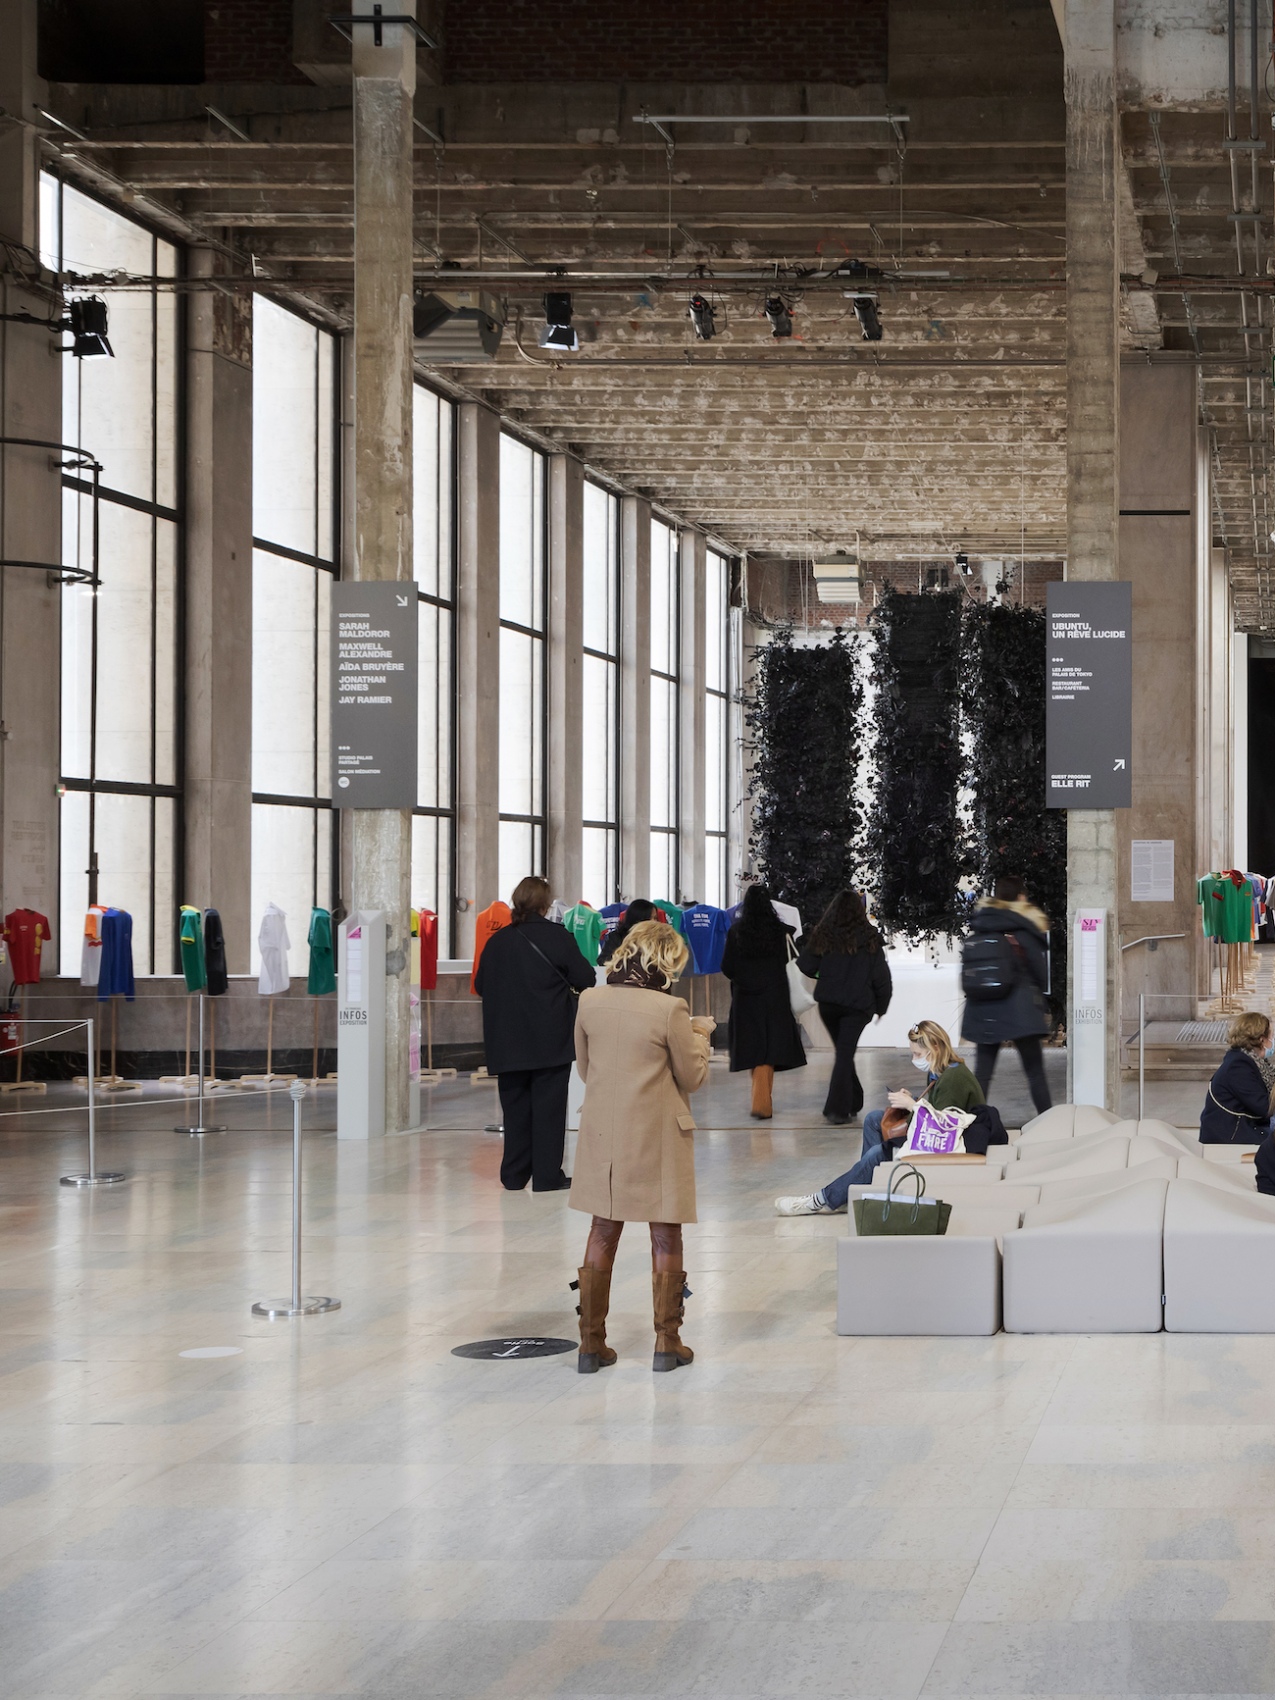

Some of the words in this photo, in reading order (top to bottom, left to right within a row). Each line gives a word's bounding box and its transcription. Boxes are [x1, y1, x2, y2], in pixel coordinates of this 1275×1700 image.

[1052, 623, 1092, 631] UBUNTU,
[339, 630, 390, 638] MALDOROR
[1067, 628, 1091, 638] RÊVE
[339, 650, 392, 658] ALEXANDRE
[339, 663, 361, 671] AÏDA
[362, 662, 404, 671] BRUYÈRE
[339, 683, 369, 691] JONES
[339, 696, 356, 704] JAY
[357, 696, 392, 704] RAMIER
[1051, 780, 1074, 788] ELLE
[1075, 780, 1091, 788] RIT
[339, 1010, 367, 1020] INFOS
[1075, 1009, 1103, 1019] INFOS
[920, 1117, 928, 1133] À
[919, 1134, 947, 1150] FAIRE
